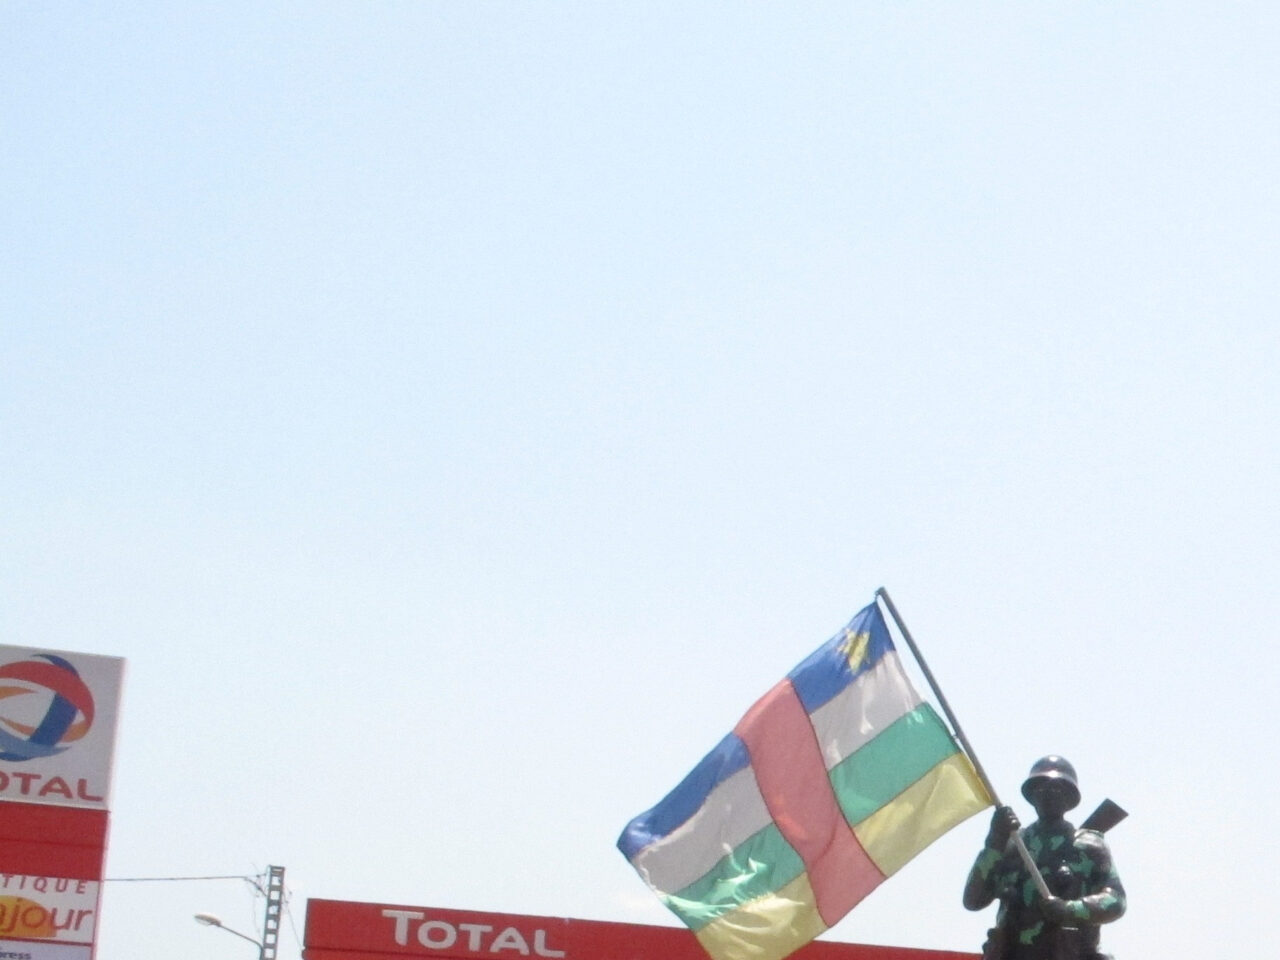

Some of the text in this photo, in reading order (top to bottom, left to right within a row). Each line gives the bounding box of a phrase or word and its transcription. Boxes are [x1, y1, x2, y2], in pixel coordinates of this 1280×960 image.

[0, 772, 104, 802] TAL
[0, 898, 93, 934] jour
[382, 909, 565, 958] TOTAL
